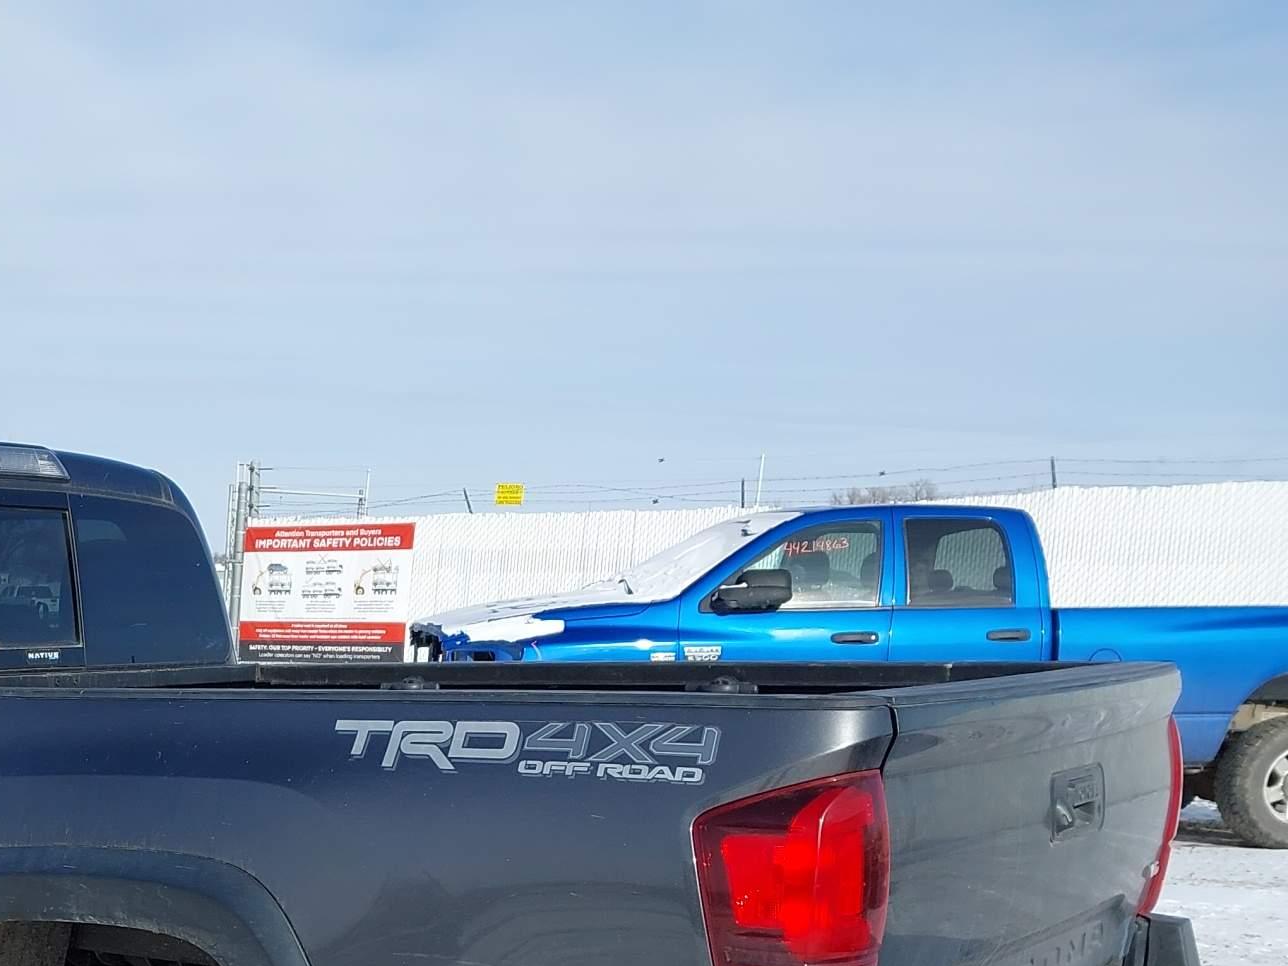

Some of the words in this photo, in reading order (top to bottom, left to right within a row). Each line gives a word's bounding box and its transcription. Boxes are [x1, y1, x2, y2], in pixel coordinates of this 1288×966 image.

[255, 538, 311, 548] IMPORTANT
[313, 537, 351, 548] SAFETY
[353, 536, 401, 547] POLICIES
[305, 529, 344, 538] Transporters
[360, 529, 381, 537] Buyers
[334, 719, 522, 773] TRD
[516, 759, 593, 778] OFF
[596, 763, 707, 785] ROAD
